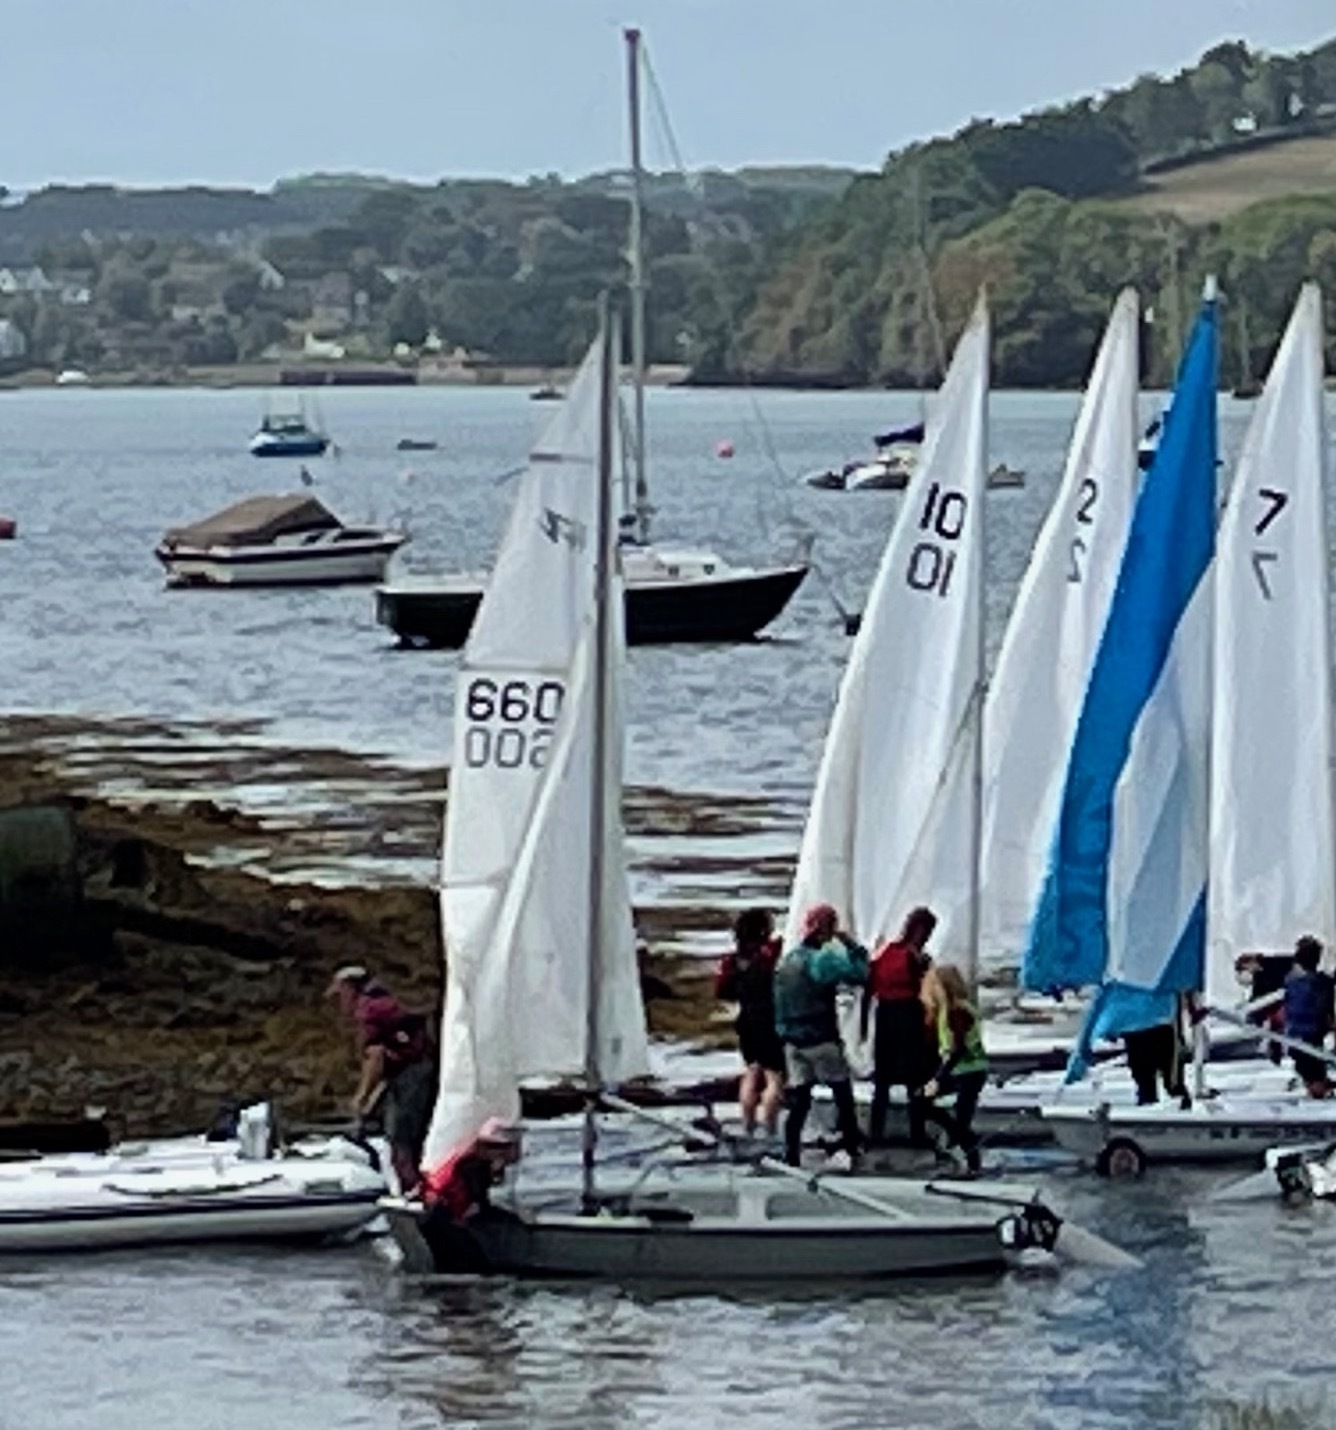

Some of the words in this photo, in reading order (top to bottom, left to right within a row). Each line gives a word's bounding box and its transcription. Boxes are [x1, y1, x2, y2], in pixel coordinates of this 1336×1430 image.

[920, 482, 967, 540] 10
[1076, 478, 1098, 525] 2
[1255, 488, 1288, 536] 7
[466, 678, 565, 724] 660
